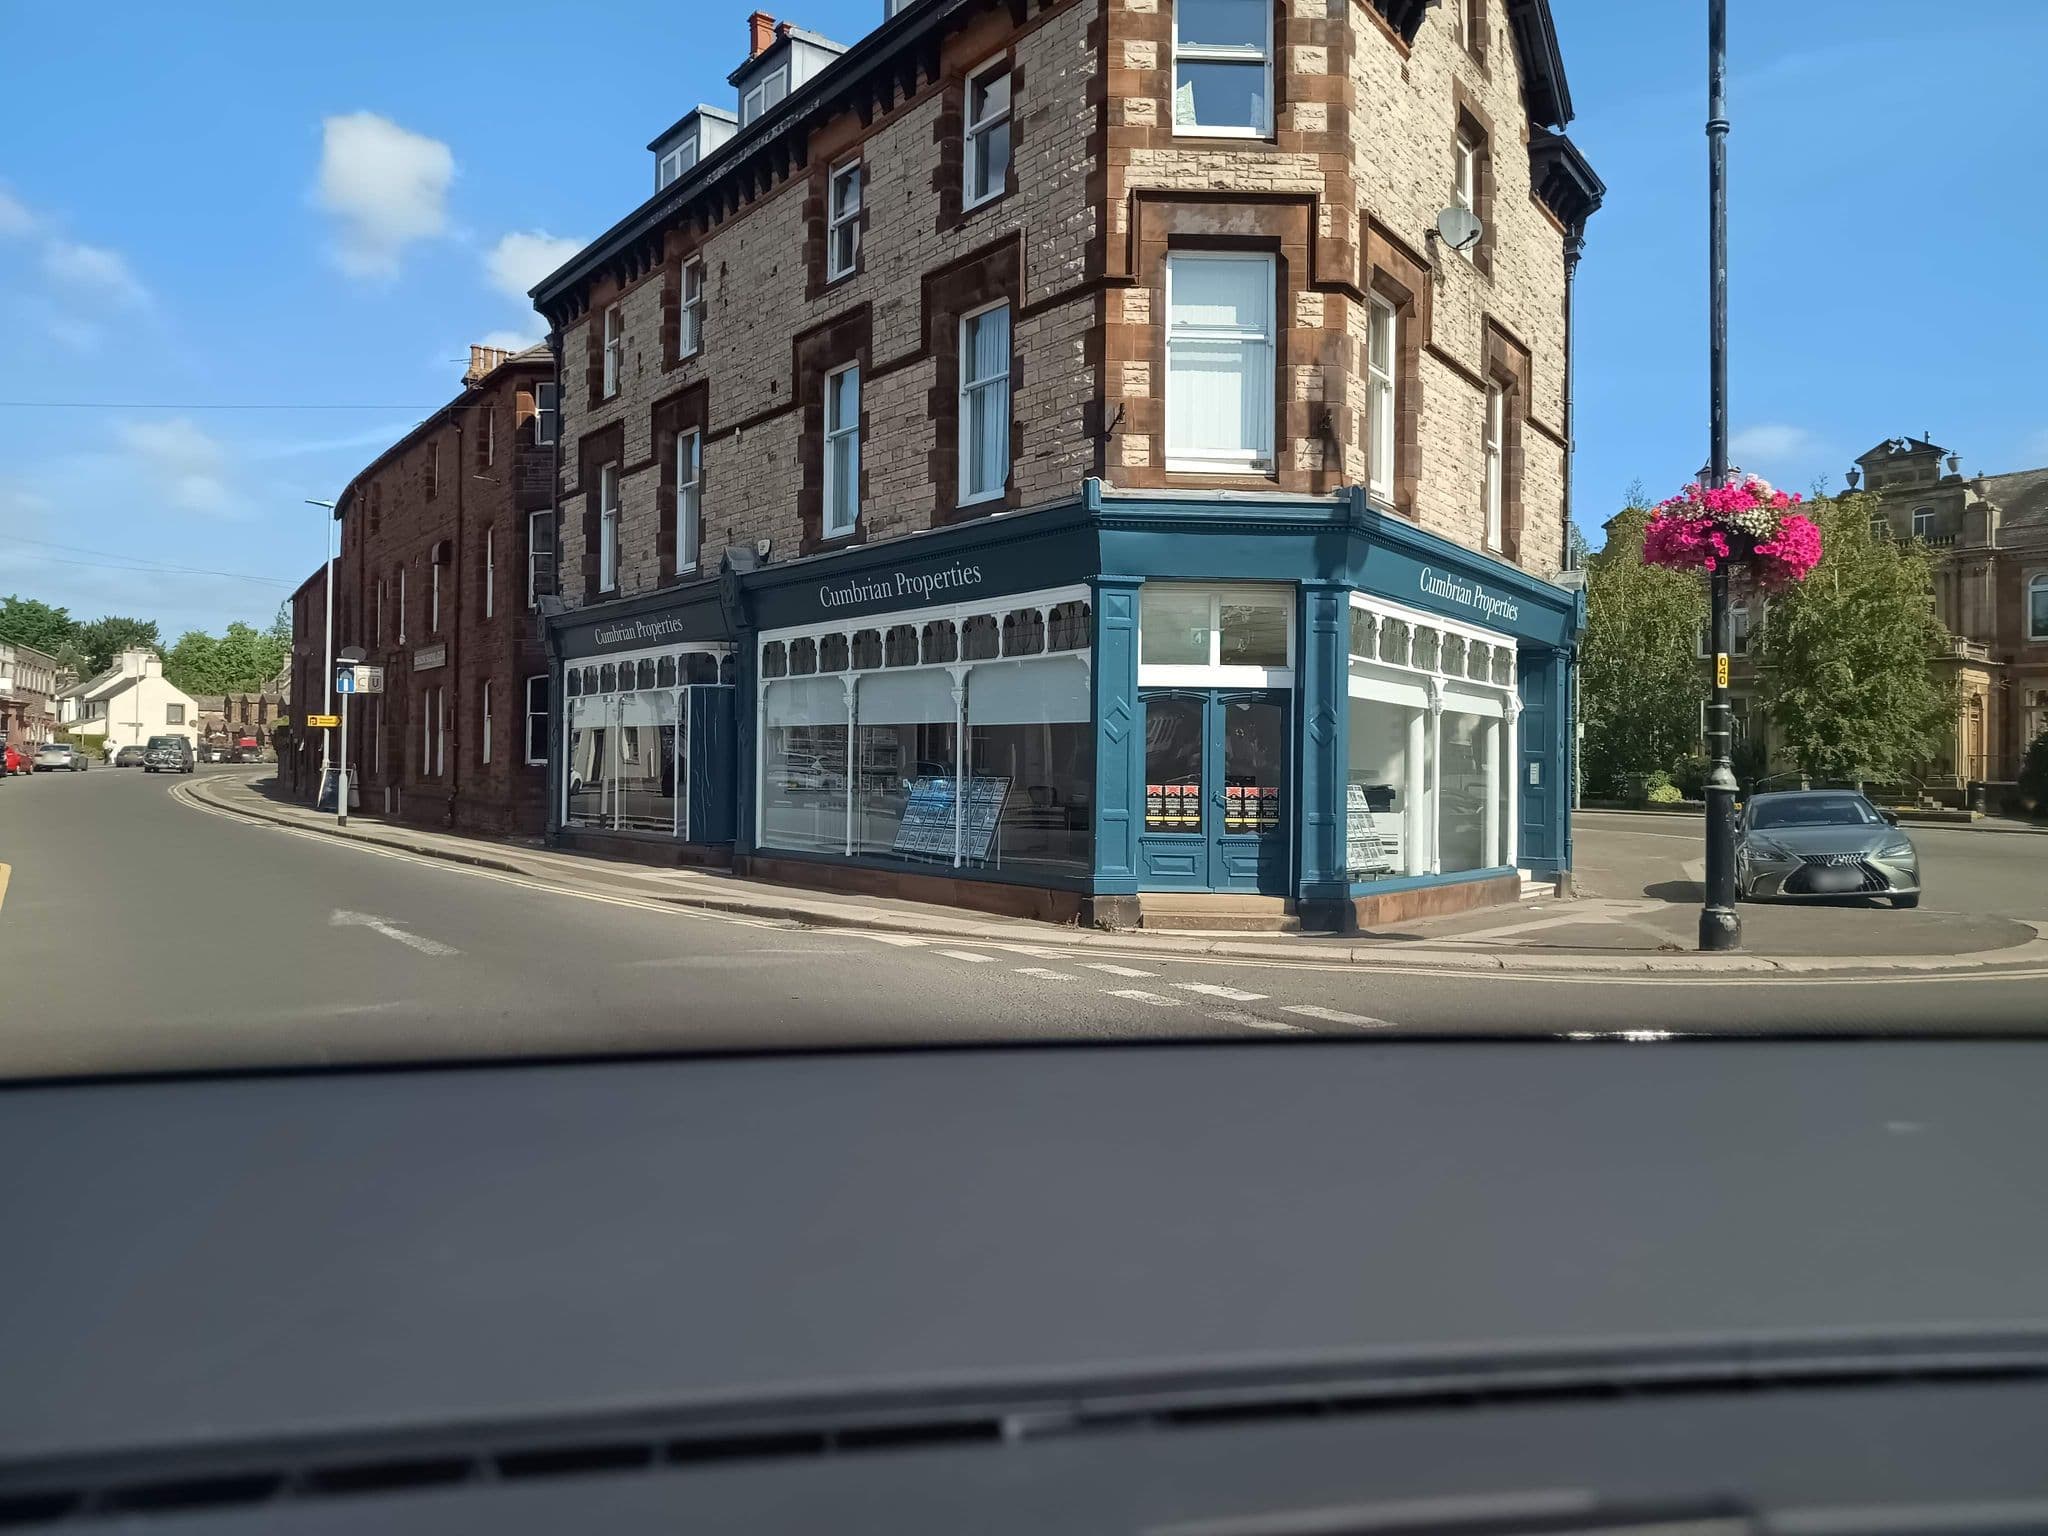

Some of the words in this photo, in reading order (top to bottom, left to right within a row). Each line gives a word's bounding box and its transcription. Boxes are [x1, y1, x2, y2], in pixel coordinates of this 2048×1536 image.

[819, 577, 893, 608] Cumbrian
[894, 561, 982, 600] Properties
[1420, 567, 1472, 605] Cumbrian
[1472, 585, 1519, 621] Properties
[594, 623, 637, 645] Cumbrian
[636, 614, 684, 641] Properties
[1719, 657, 1727, 685] 040
